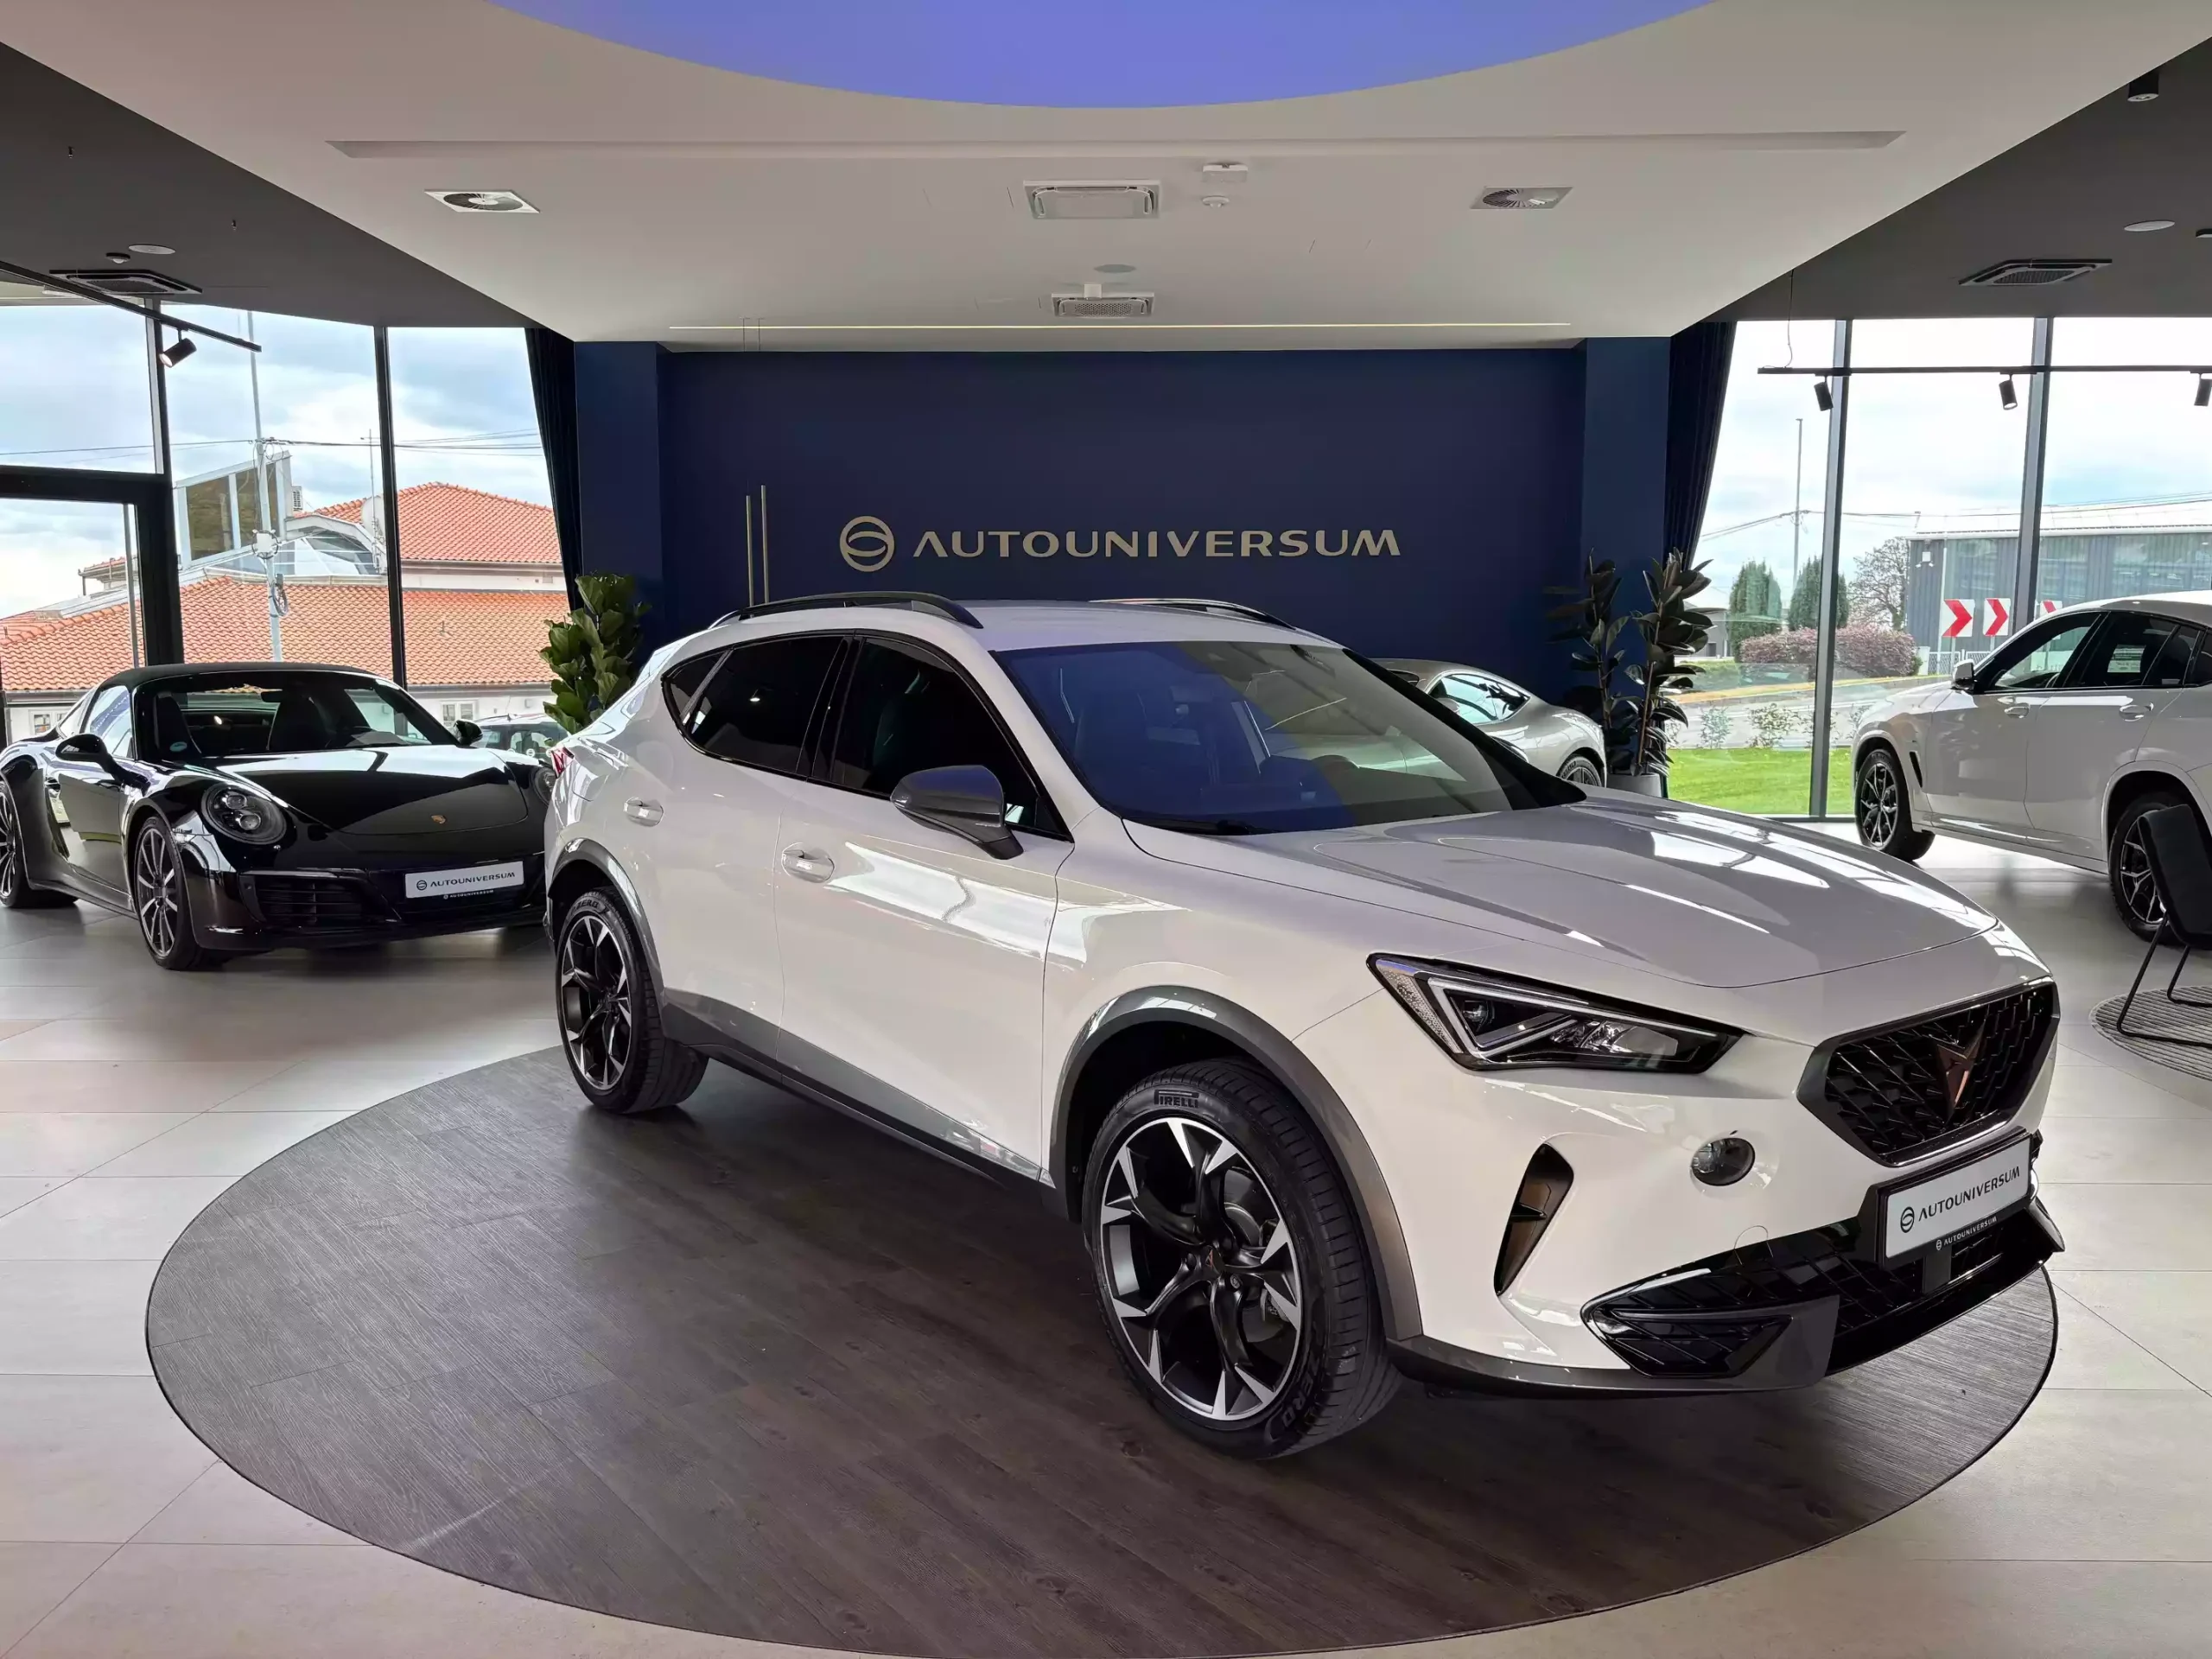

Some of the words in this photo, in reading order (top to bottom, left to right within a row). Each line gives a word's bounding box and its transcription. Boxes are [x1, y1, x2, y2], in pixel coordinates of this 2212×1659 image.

[912, 530, 1402, 558] AUTOUNIVERSUM
[430, 872, 516, 887] AUTOUNIVERSUM
[449, 889, 494, 899] AUTOUNIVERSUM
[1154, 1089, 1200, 1109] PIRELLI
[1918, 1166, 2020, 1222] AUTOUNIVERSUM
[1943, 1216, 1998, 1246] AUTOUNIVERSUM
